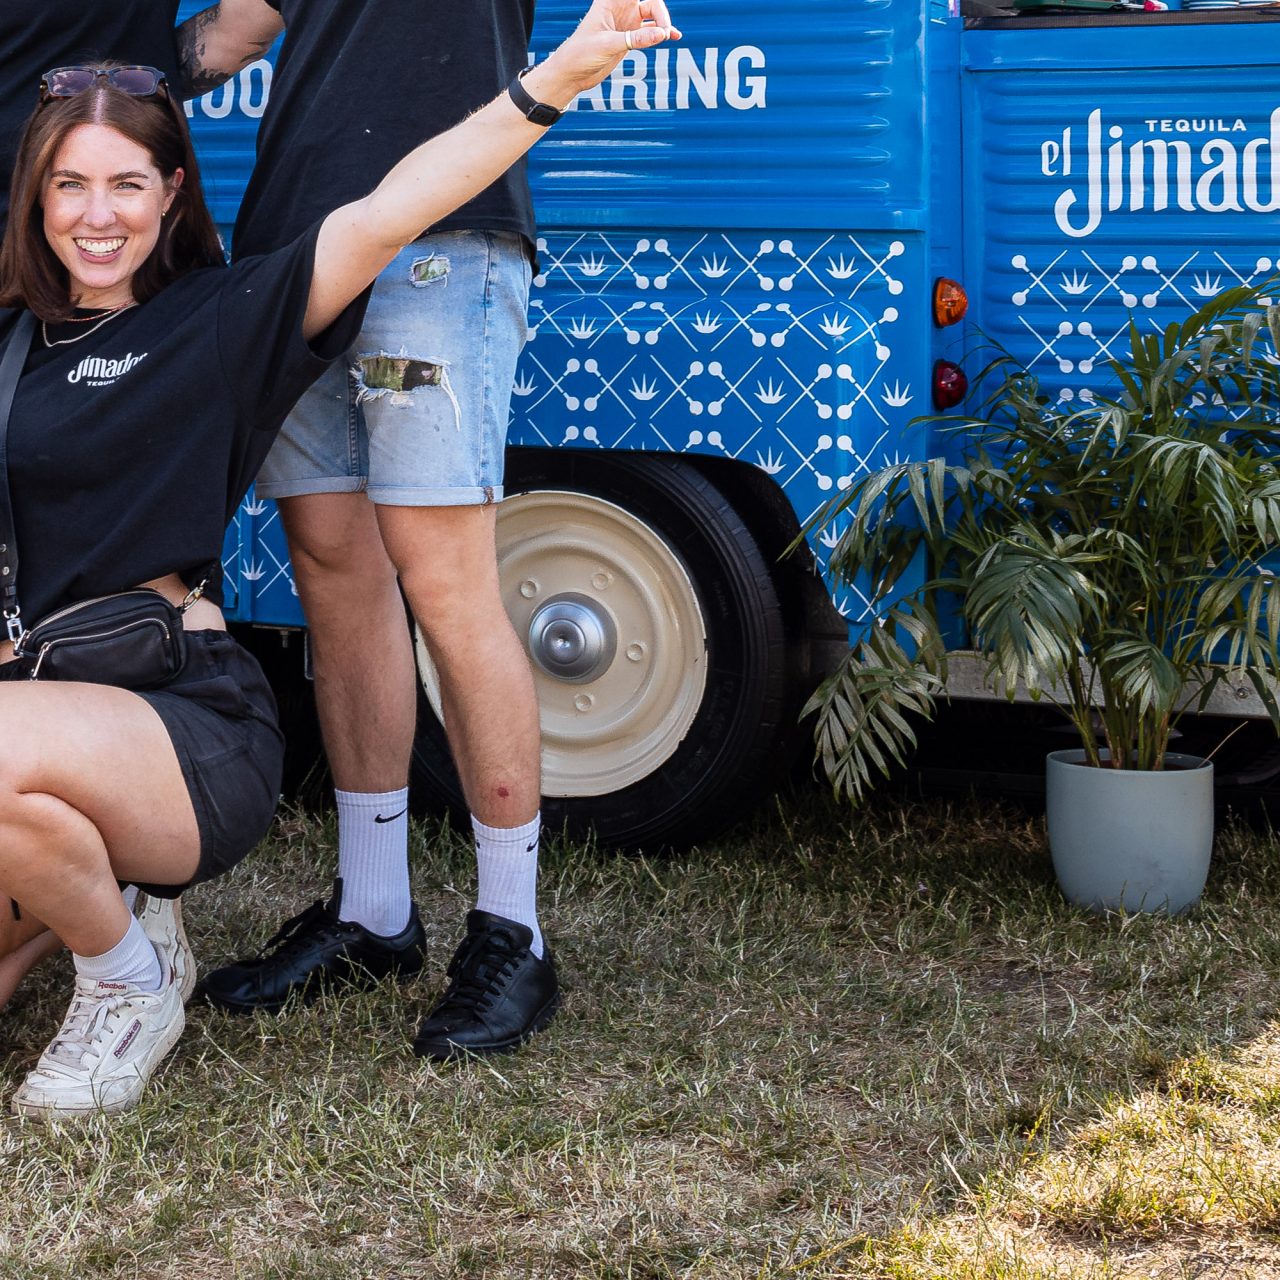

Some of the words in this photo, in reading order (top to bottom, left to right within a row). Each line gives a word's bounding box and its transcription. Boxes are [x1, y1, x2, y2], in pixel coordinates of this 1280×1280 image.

[1145, 119, 1248, 133] TEQUILA
[1041, 126, 1072, 177] el
[98, 981, 127, 990] Reebok
[113, 1031, 135, 1057] Reebok
